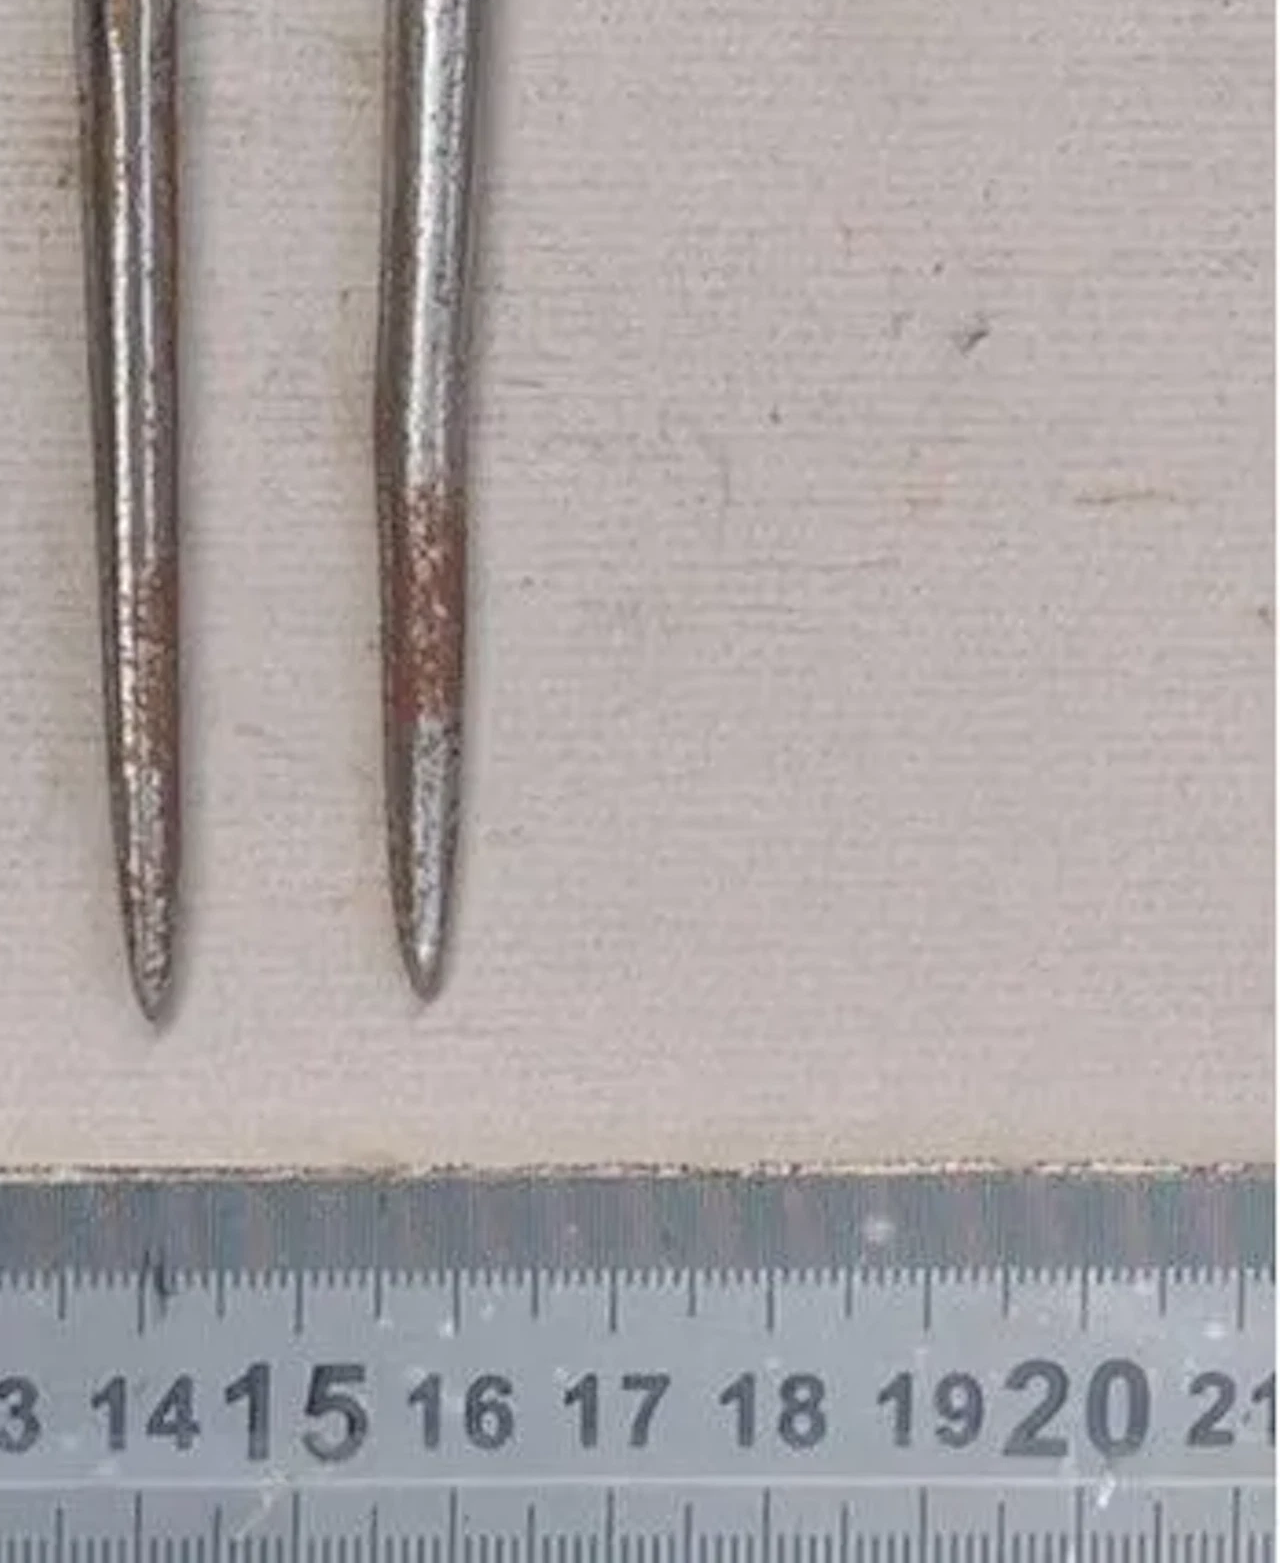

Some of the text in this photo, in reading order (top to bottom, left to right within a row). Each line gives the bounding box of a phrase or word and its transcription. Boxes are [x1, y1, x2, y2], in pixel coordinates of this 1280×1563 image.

[91, 1375, 200, 1451] 14
[225, 1363, 369, 1463] 15
[407, 1374, 514, 1450] 16
[563, 1374, 670, 1448] 17
[720, 1373, 827, 1448] 18
[876, 1373, 984, 1448] 19
[1003, 1359, 1150, 1459] 20
